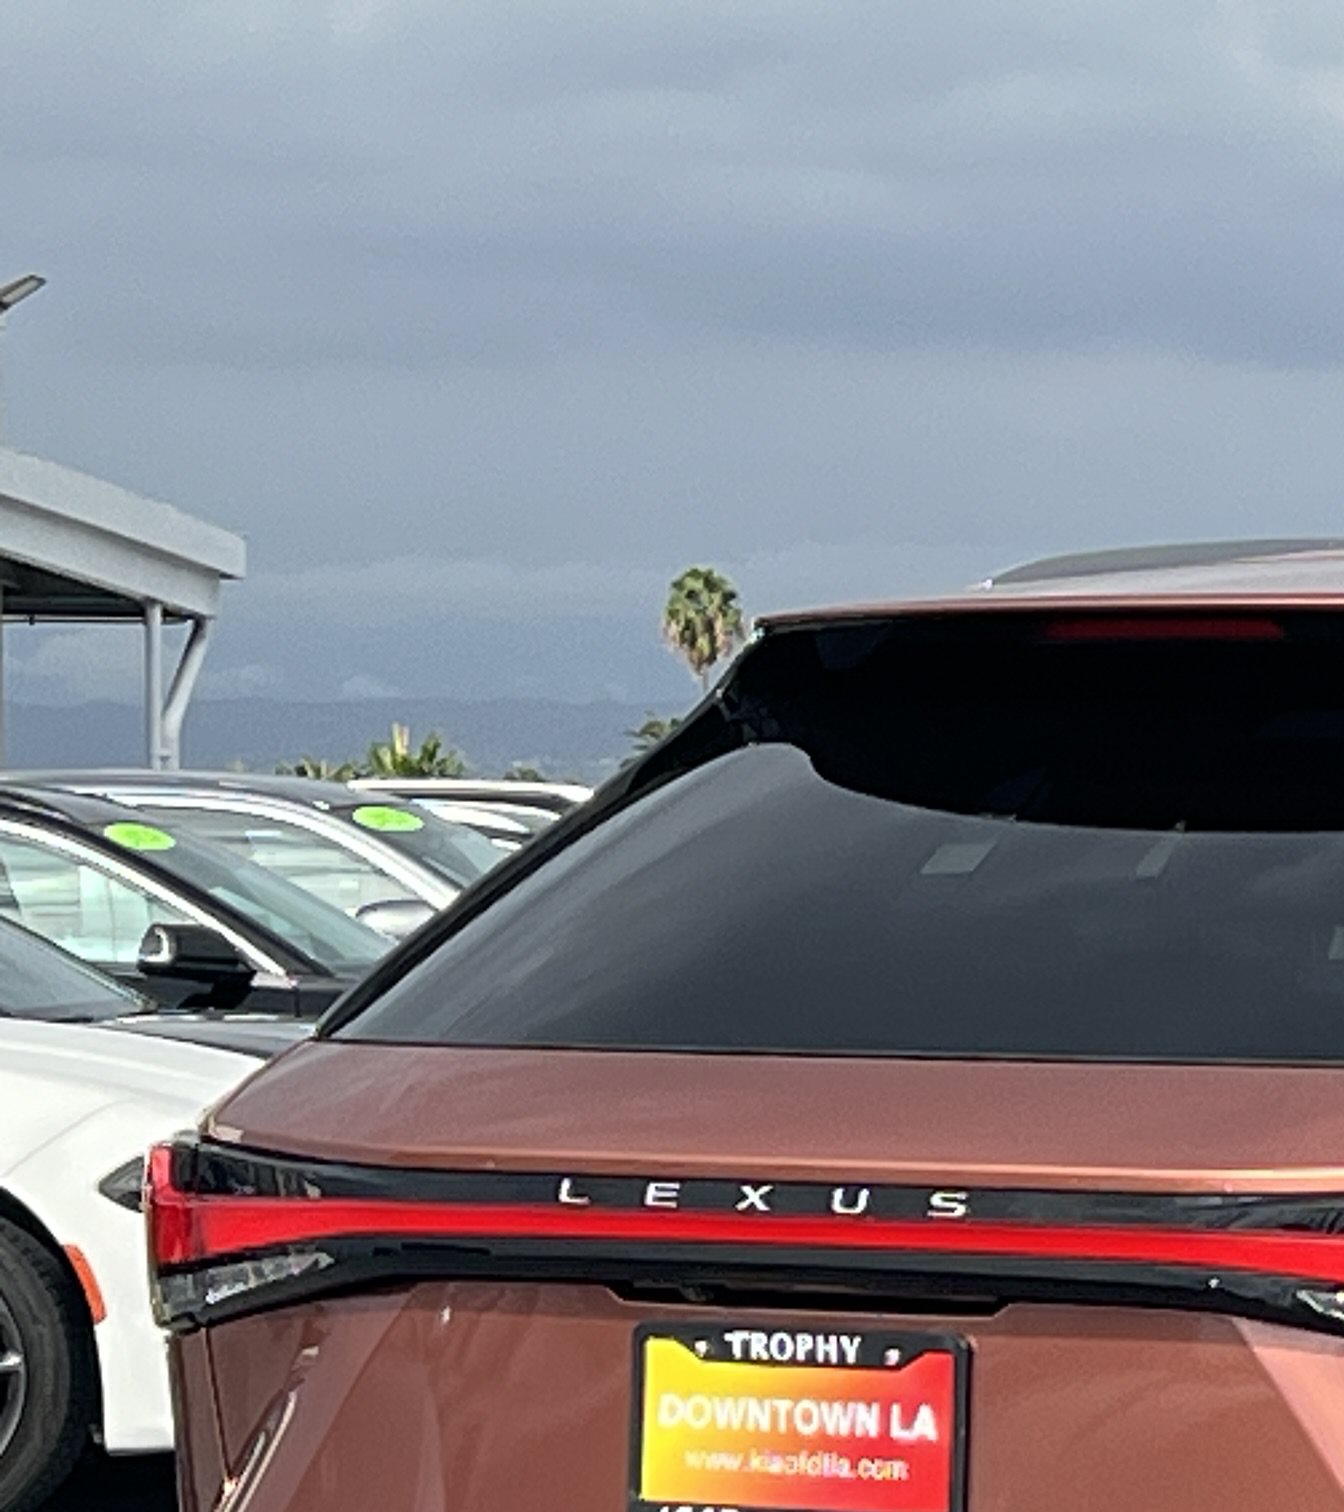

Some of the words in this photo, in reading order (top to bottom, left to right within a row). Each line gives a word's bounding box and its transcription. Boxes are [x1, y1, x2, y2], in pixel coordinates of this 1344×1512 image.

[558, 1177, 969, 1218] LEXUS
[724, 1330, 862, 1364] TROPHY
[657, 1393, 879, 1438] DOWNTOWN
[889, 1403, 938, 1442] LA
